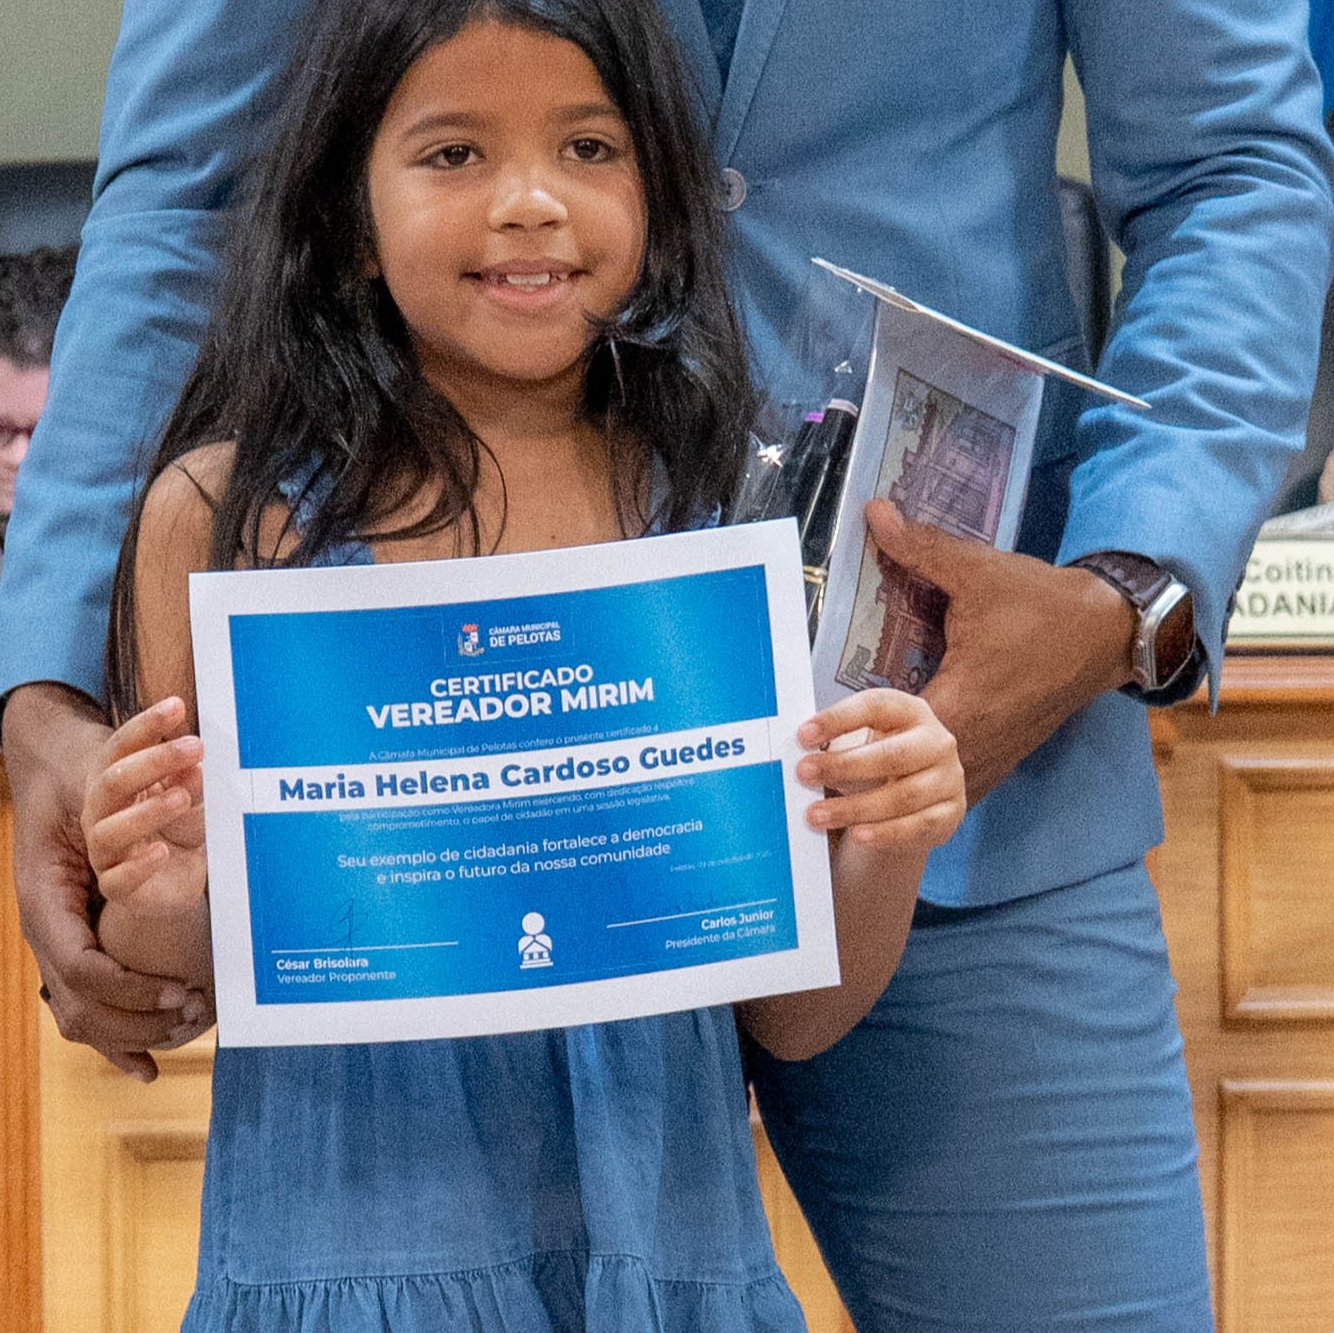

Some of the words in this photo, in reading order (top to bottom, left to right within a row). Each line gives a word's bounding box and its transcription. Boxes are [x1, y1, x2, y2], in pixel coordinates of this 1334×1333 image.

[489, 635, 506, 648] DE
[508, 629, 561, 646] PELOTAS
[521, 621, 560, 633] MUNICIPAL
[430, 663, 593, 698] CERTIFICADO
[366, 691, 552, 729] VEREADOR
[561, 677, 654, 713] MIRIM
[279, 773, 366, 802] Maria
[375, 770, 490, 797] Helena
[500, 755, 631, 788] Cardoso
[638, 737, 746, 770] Guedes
[337, 854, 366, 868] Seu
[369, 850, 436, 868] exemplo
[439, 847, 460, 862] de
[463, 840, 539, 860] cidadania
[542, 833, 608, 852] fortalece
[610, 833, 620, 844] a
[622, 817, 703, 843] democracia
[376, 873, 387, 885] e
[390, 868, 441, 885] inspira
[445, 869, 456, 880] o
[458, 864, 507, 880] futuro
[510, 861, 530, 875] da
[534, 857, 577, 872] nossa
[580, 842, 671, 867] comunidade
[701, 916, 737, 931] Carlos
[739, 909, 775, 925] Junior
[665, 932, 720, 950] Presidente
[722, 930, 735, 941] da
[736, 923, 776, 939] Câmara
[276, 958, 310, 970] César
[277, 972, 326, 984] Vereador
[329, 970, 396, 984] Proponente
